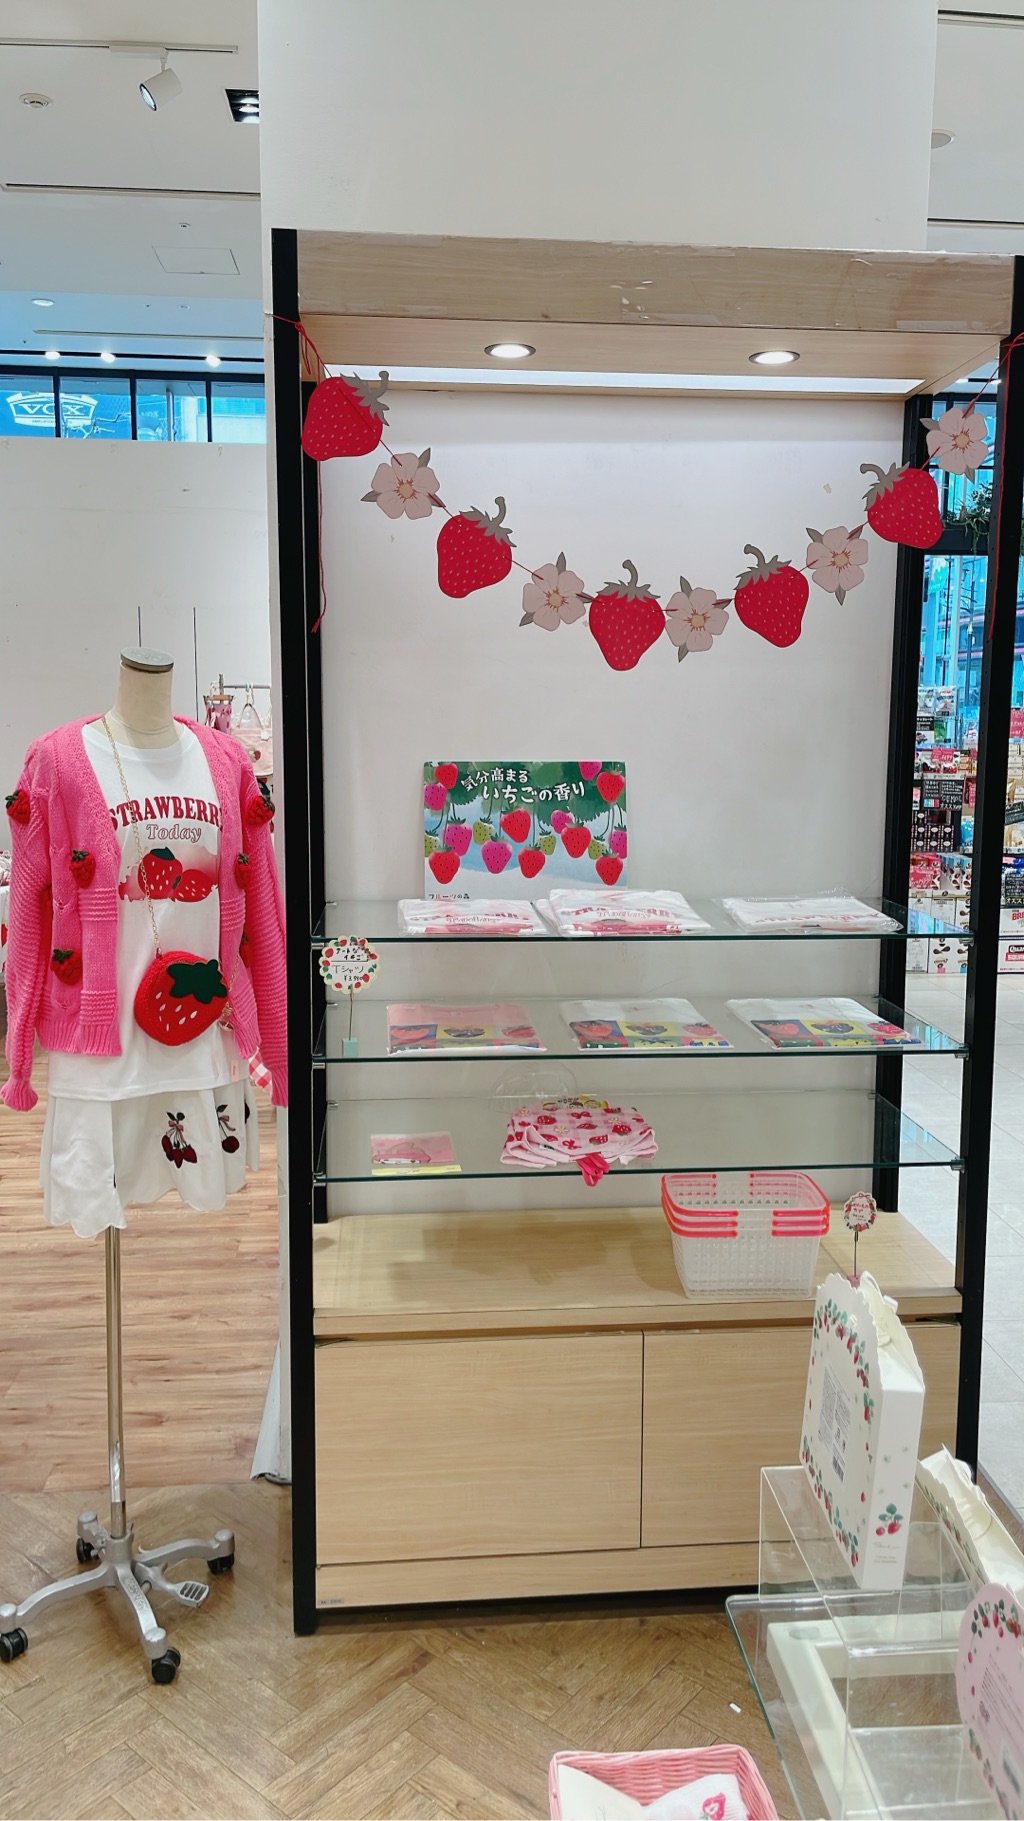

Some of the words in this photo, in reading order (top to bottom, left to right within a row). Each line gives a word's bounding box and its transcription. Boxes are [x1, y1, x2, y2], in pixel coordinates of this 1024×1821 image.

[461, 768, 528, 791] 気分高まる
[483, 781, 585, 803] いちごの香り
[109, 796, 223, 832] STRAWBERR
[146, 824, 202, 843] Today
